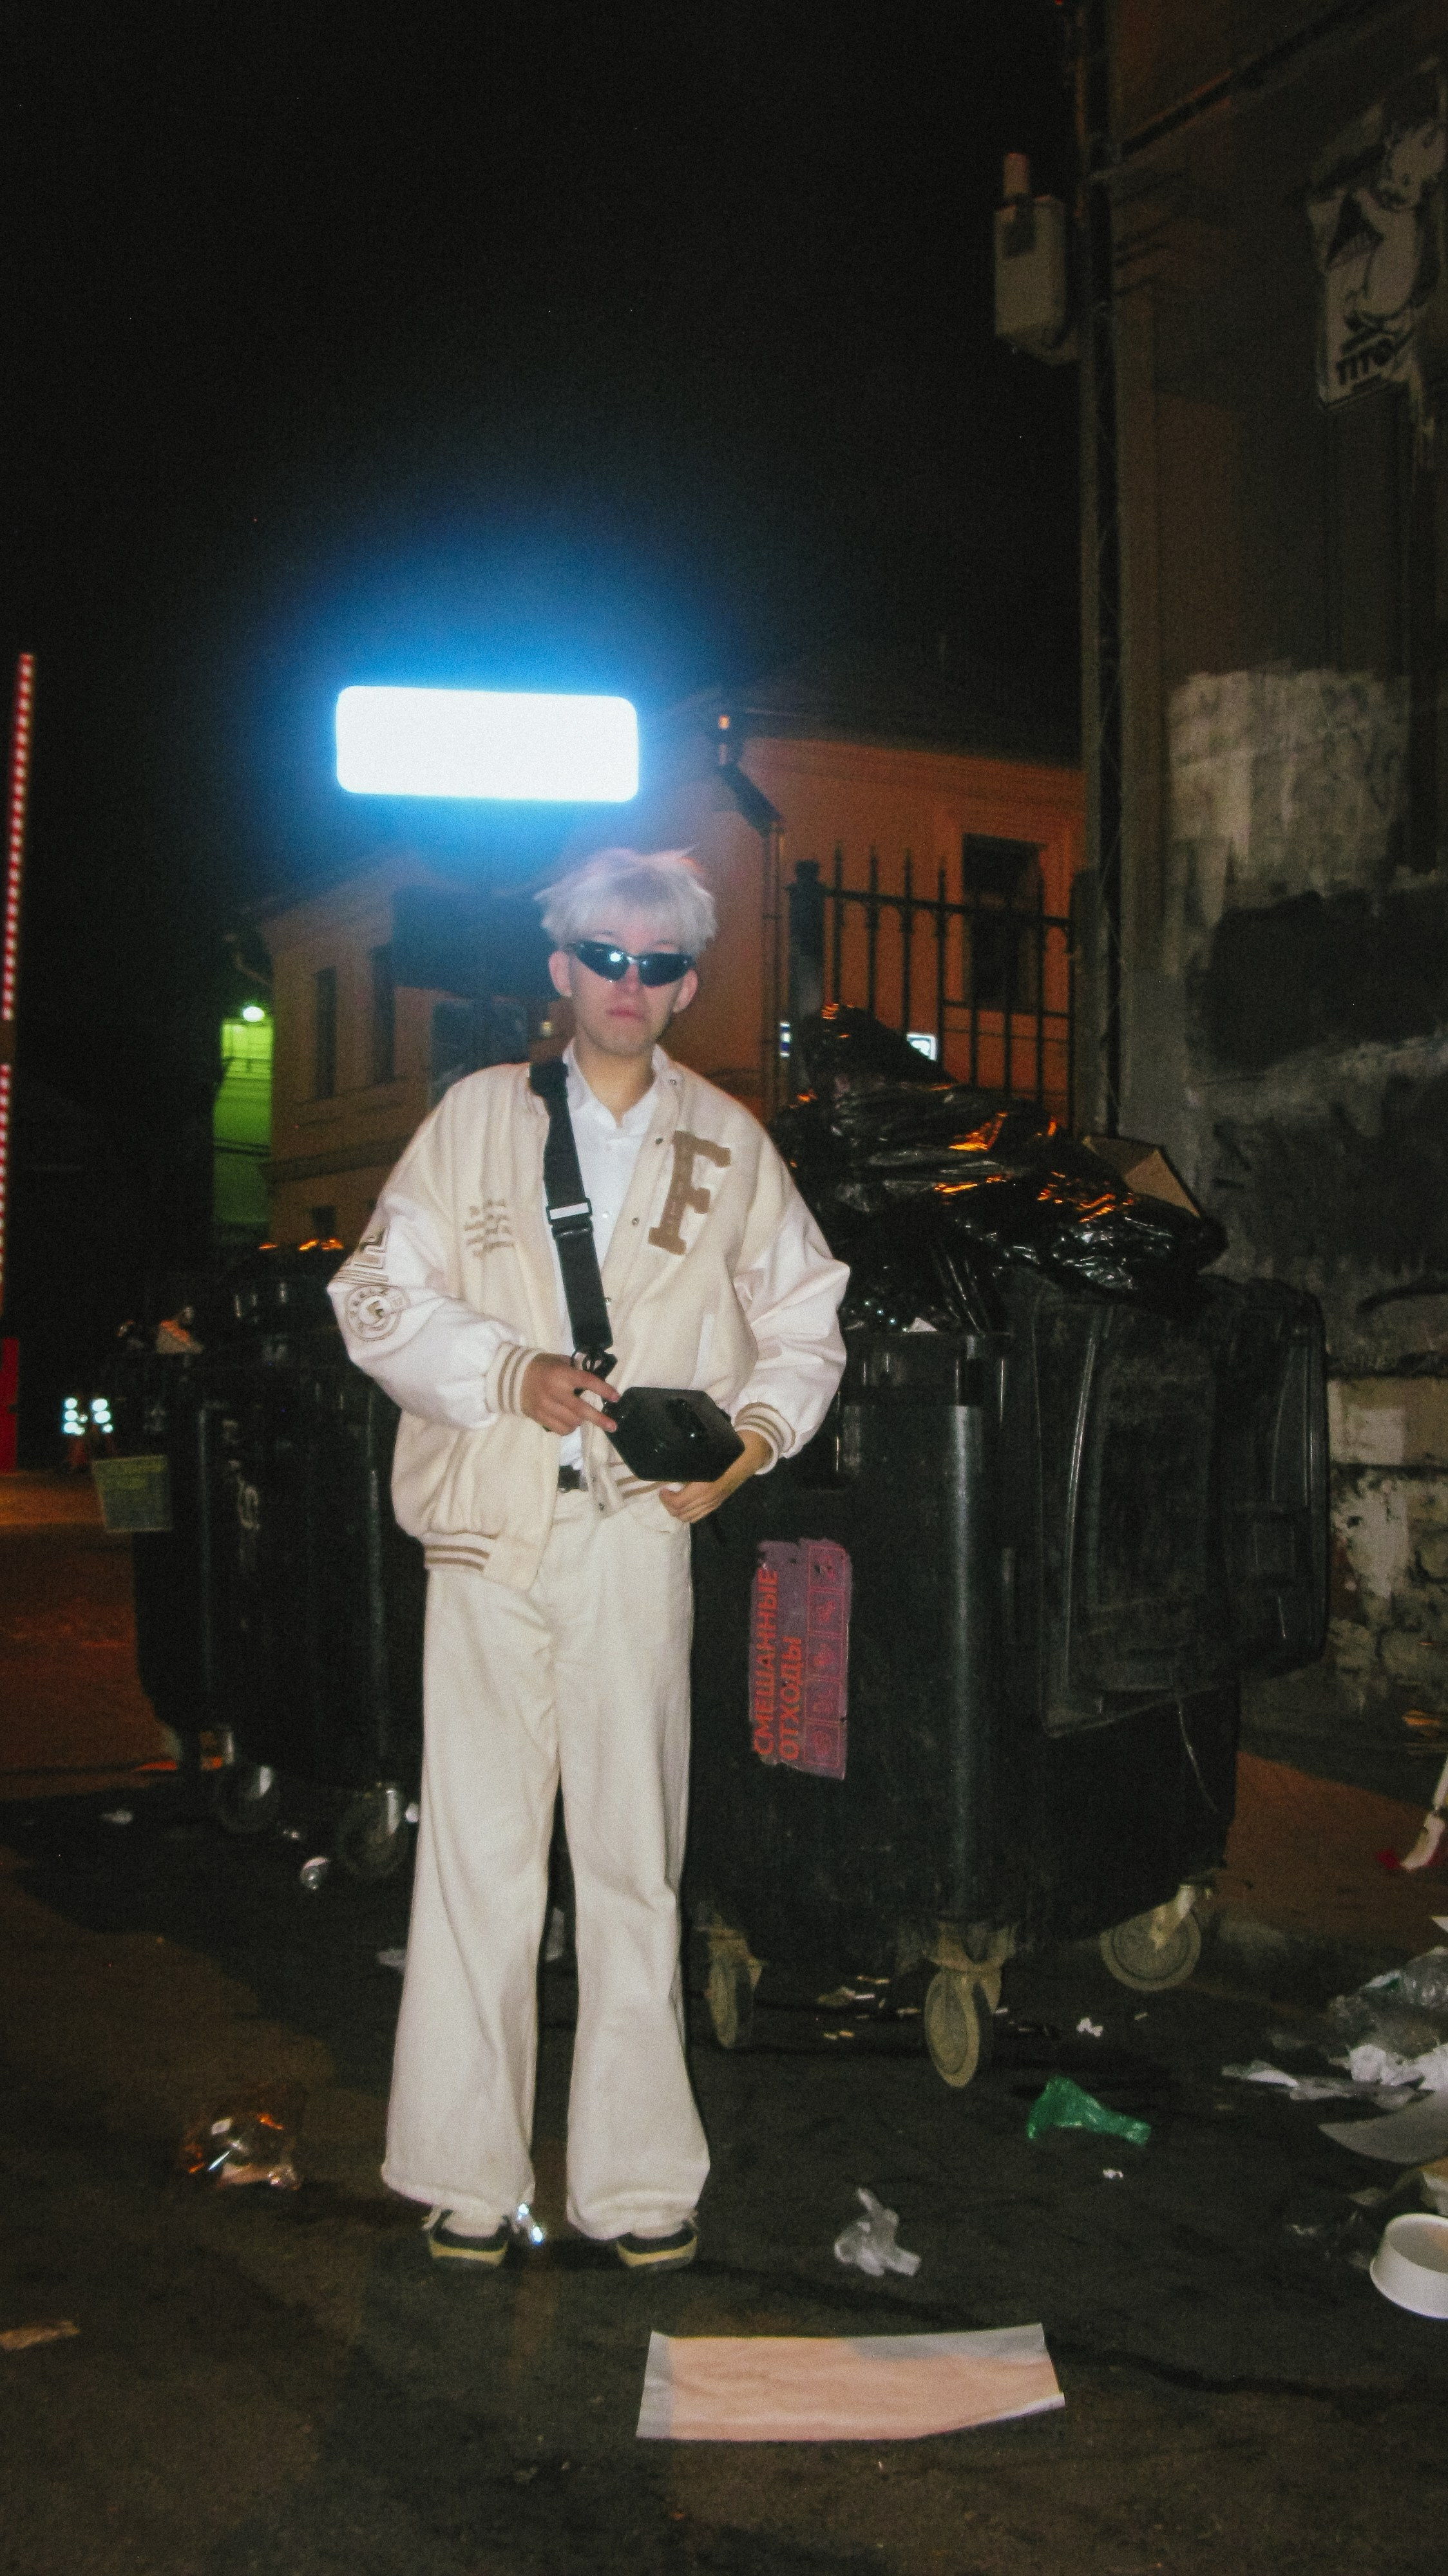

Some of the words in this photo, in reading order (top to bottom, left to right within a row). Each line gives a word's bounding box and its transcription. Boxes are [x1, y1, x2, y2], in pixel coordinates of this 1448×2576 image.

[648, 1130, 731, 1255] F
[753, 1569, 779, 1756] СМЕШАННЫЕ
[779, 1636, 803, 1760] ОТХОДЫ
